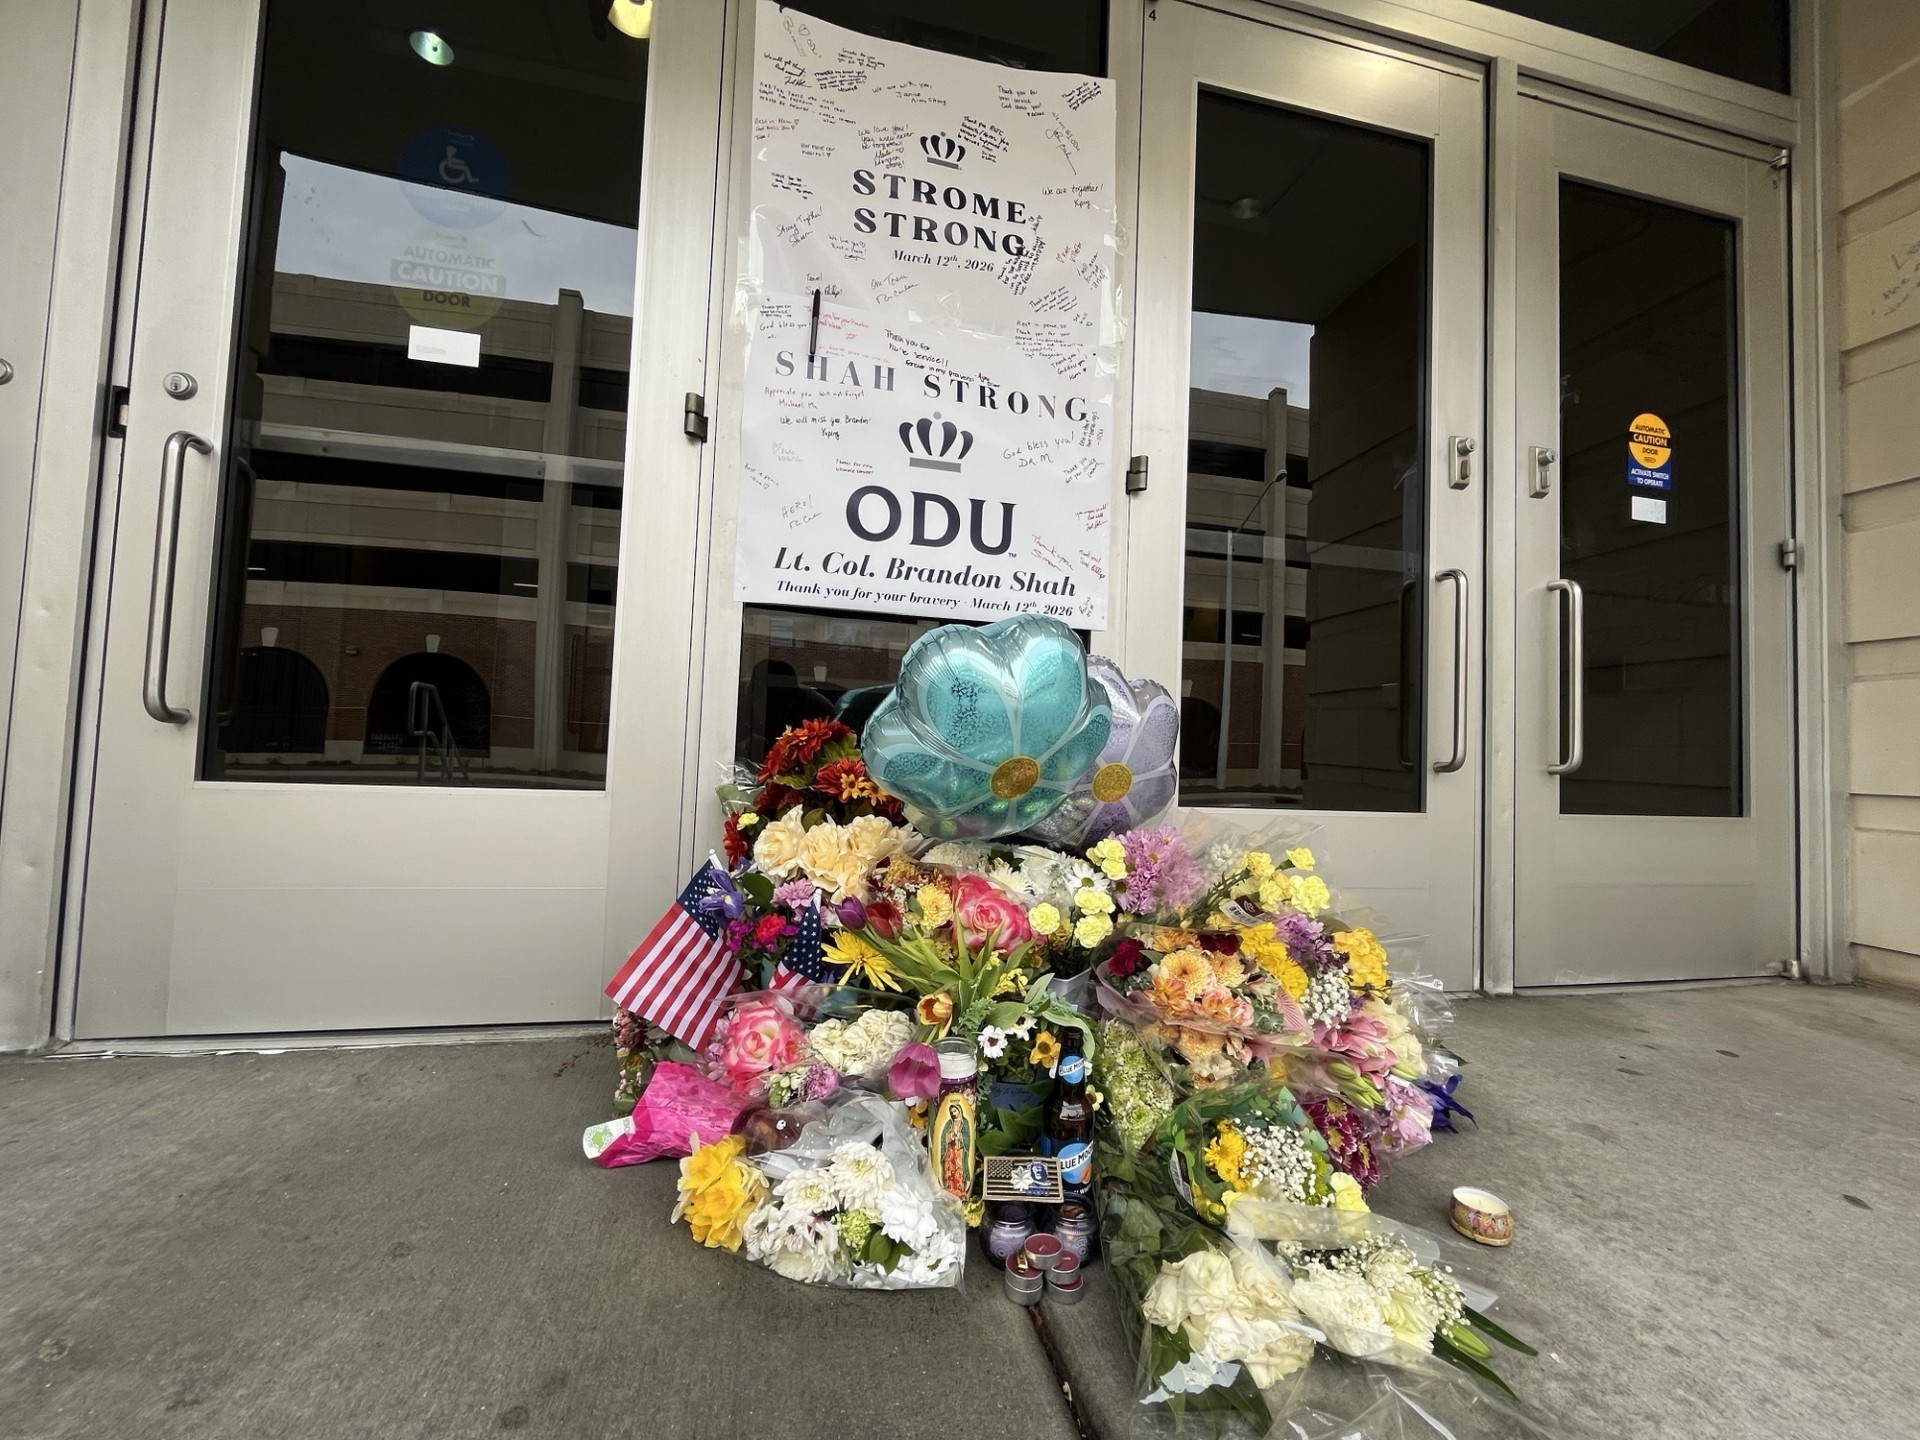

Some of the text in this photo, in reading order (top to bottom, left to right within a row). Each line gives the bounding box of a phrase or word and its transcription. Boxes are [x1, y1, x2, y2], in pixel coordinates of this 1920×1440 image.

[1149, 9, 1156, 21] 4
[853, 169, 1026, 224] STROME
[1042, 187, 1053, 195] We
[853, 207, 1026, 257] STRONG
[403, 246, 496, 270] AUTOMATIC
[892, 250, 931, 265] March
[964, 259, 995, 272] 2026
[397, 263, 499, 293] CAUTION
[423, 290, 471, 308] DOOR
[885, 329, 903, 342] Thank
[776, 351, 895, 391] SHAH
[924, 374, 1087, 421] STRONG
[780, 416, 792, 425] We
[1635, 424, 1665, 435] AUTOMATIC
[1633, 434, 1667, 446] CAUTION
[1642, 447, 1658, 456] DOOR
[1644, 478, 1663, 488] OPERATE
[846, 485, 1017, 555] ODU
[773, 547, 810, 571] Lt.
[822, 551, 874, 577] Col.
[885, 557, 1002, 590] Brandon
[1010, 570, 1076, 597] Shah
[777, 580, 821, 595] Thank
[824, 587, 849, 598] you
[850, 587, 872, 600] for
[874, 591, 906, 603] your
[909, 592, 960, 609] bravery
[970, 598, 1011, 612] March
[1043, 605, 1073, 617] 2026
[1061, 1159, 1076, 1169] LUE
